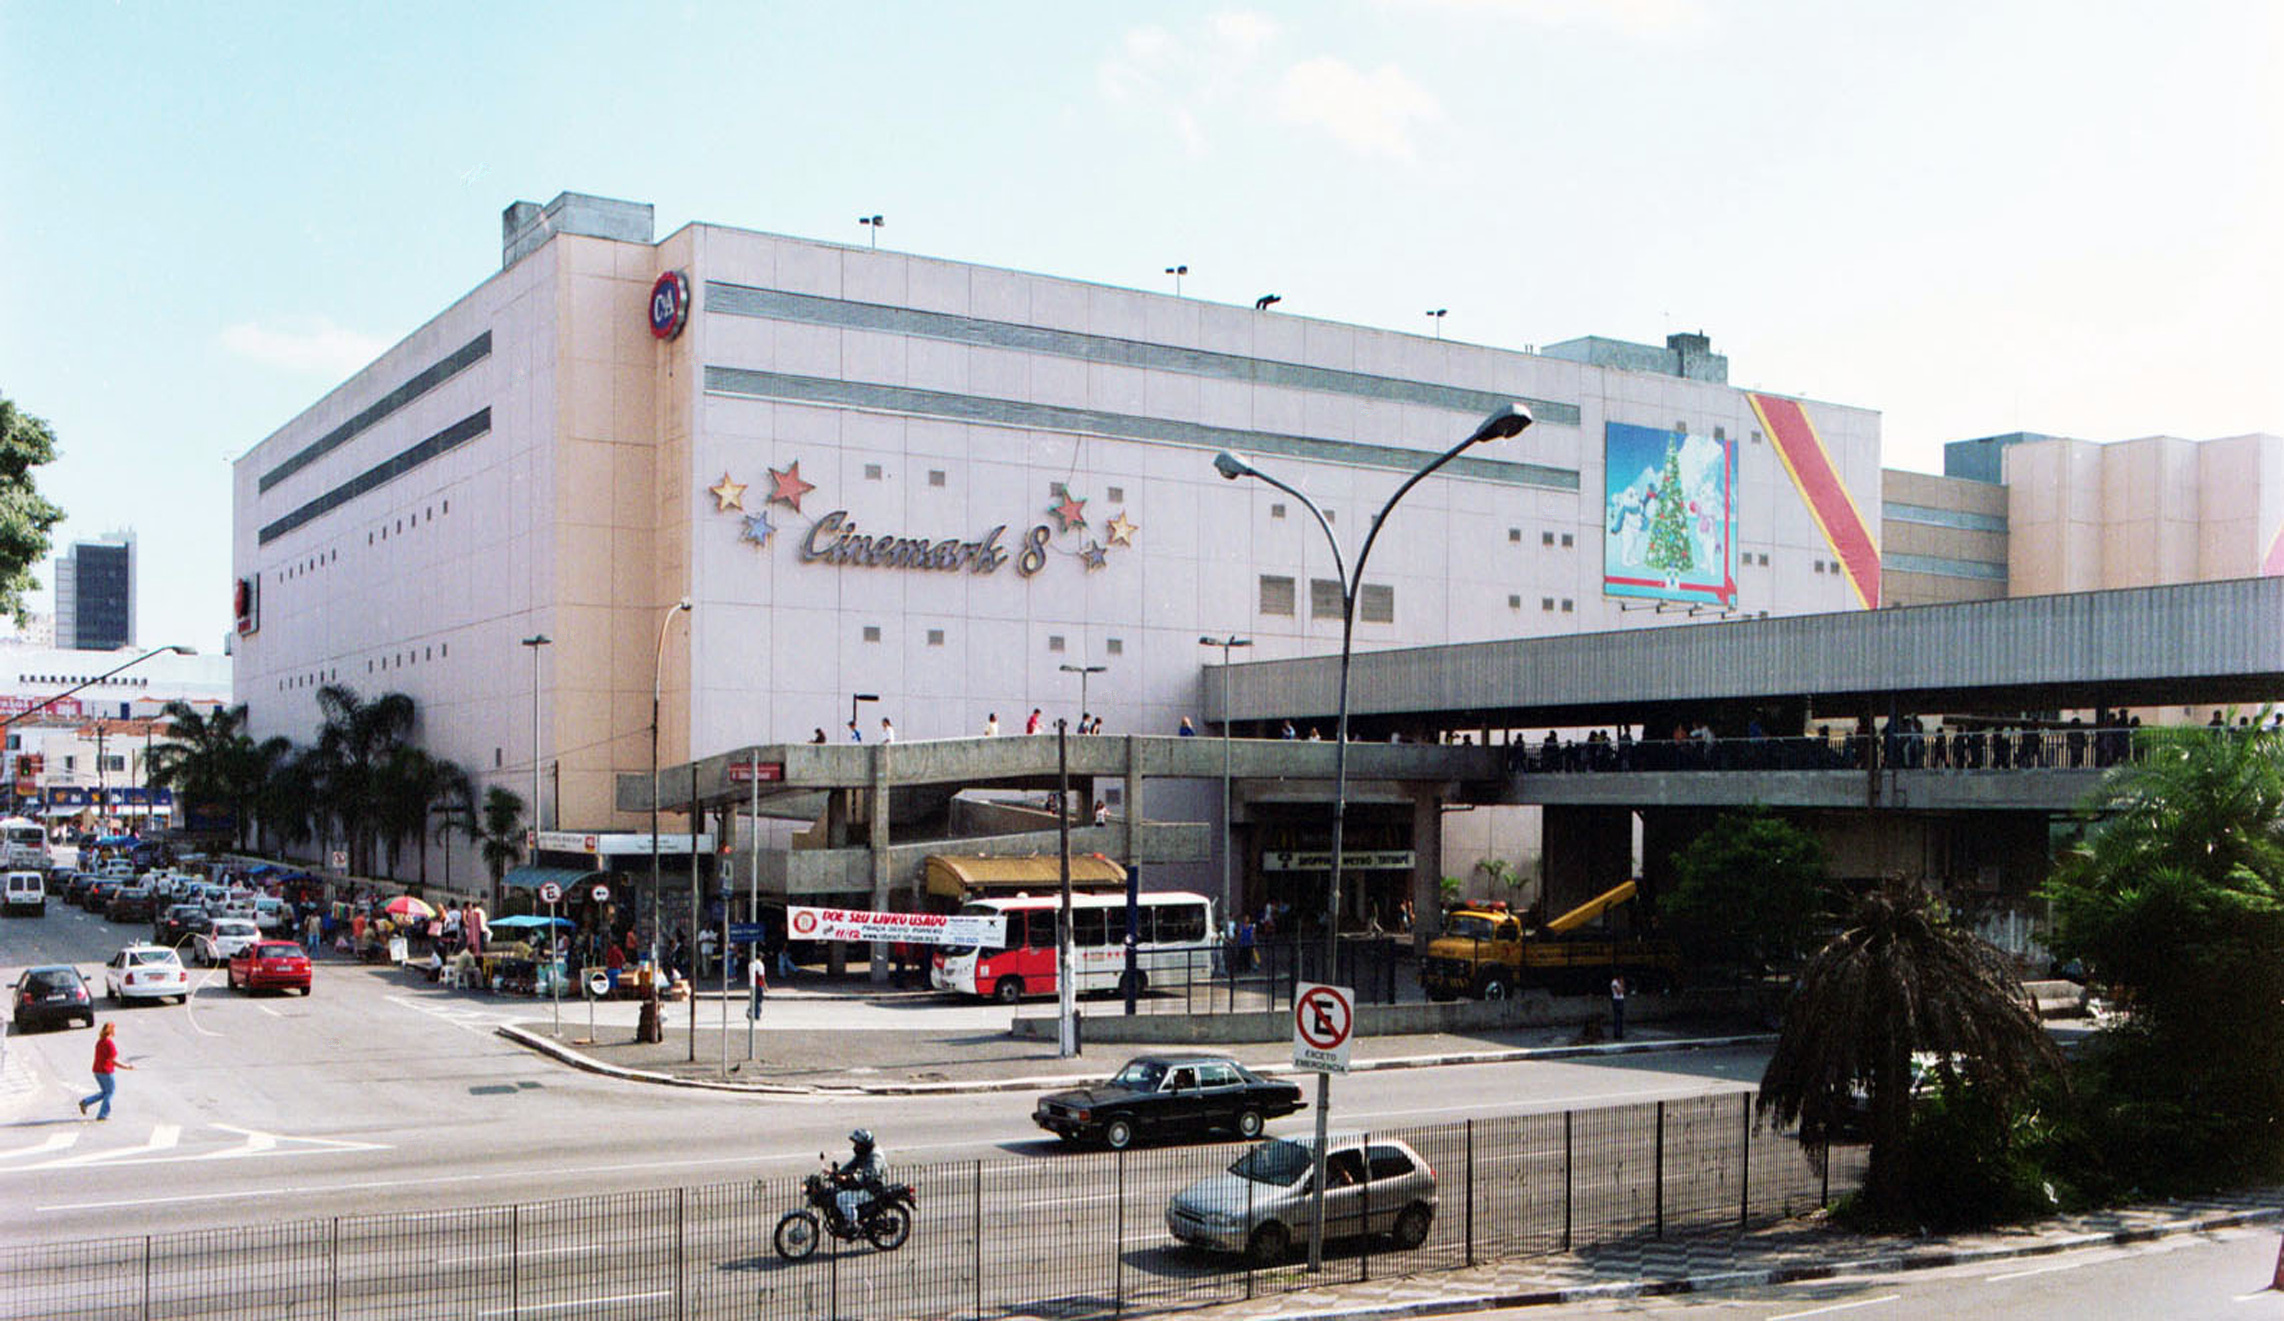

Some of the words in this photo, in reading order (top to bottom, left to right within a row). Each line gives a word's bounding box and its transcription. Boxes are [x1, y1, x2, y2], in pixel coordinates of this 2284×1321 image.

[800, 510, 1008, 574] Cinemark
[1016, 524, 1050, 577] 8
[822, 910, 845, 922] DOE
[849, 911, 870, 925] SEU
[872, 913, 908, 926] LIVRO
[908, 915, 947, 927] USADO
[1314, 1000, 1334, 1036] E
[1305, 1049, 1337, 1062] EXCETO
